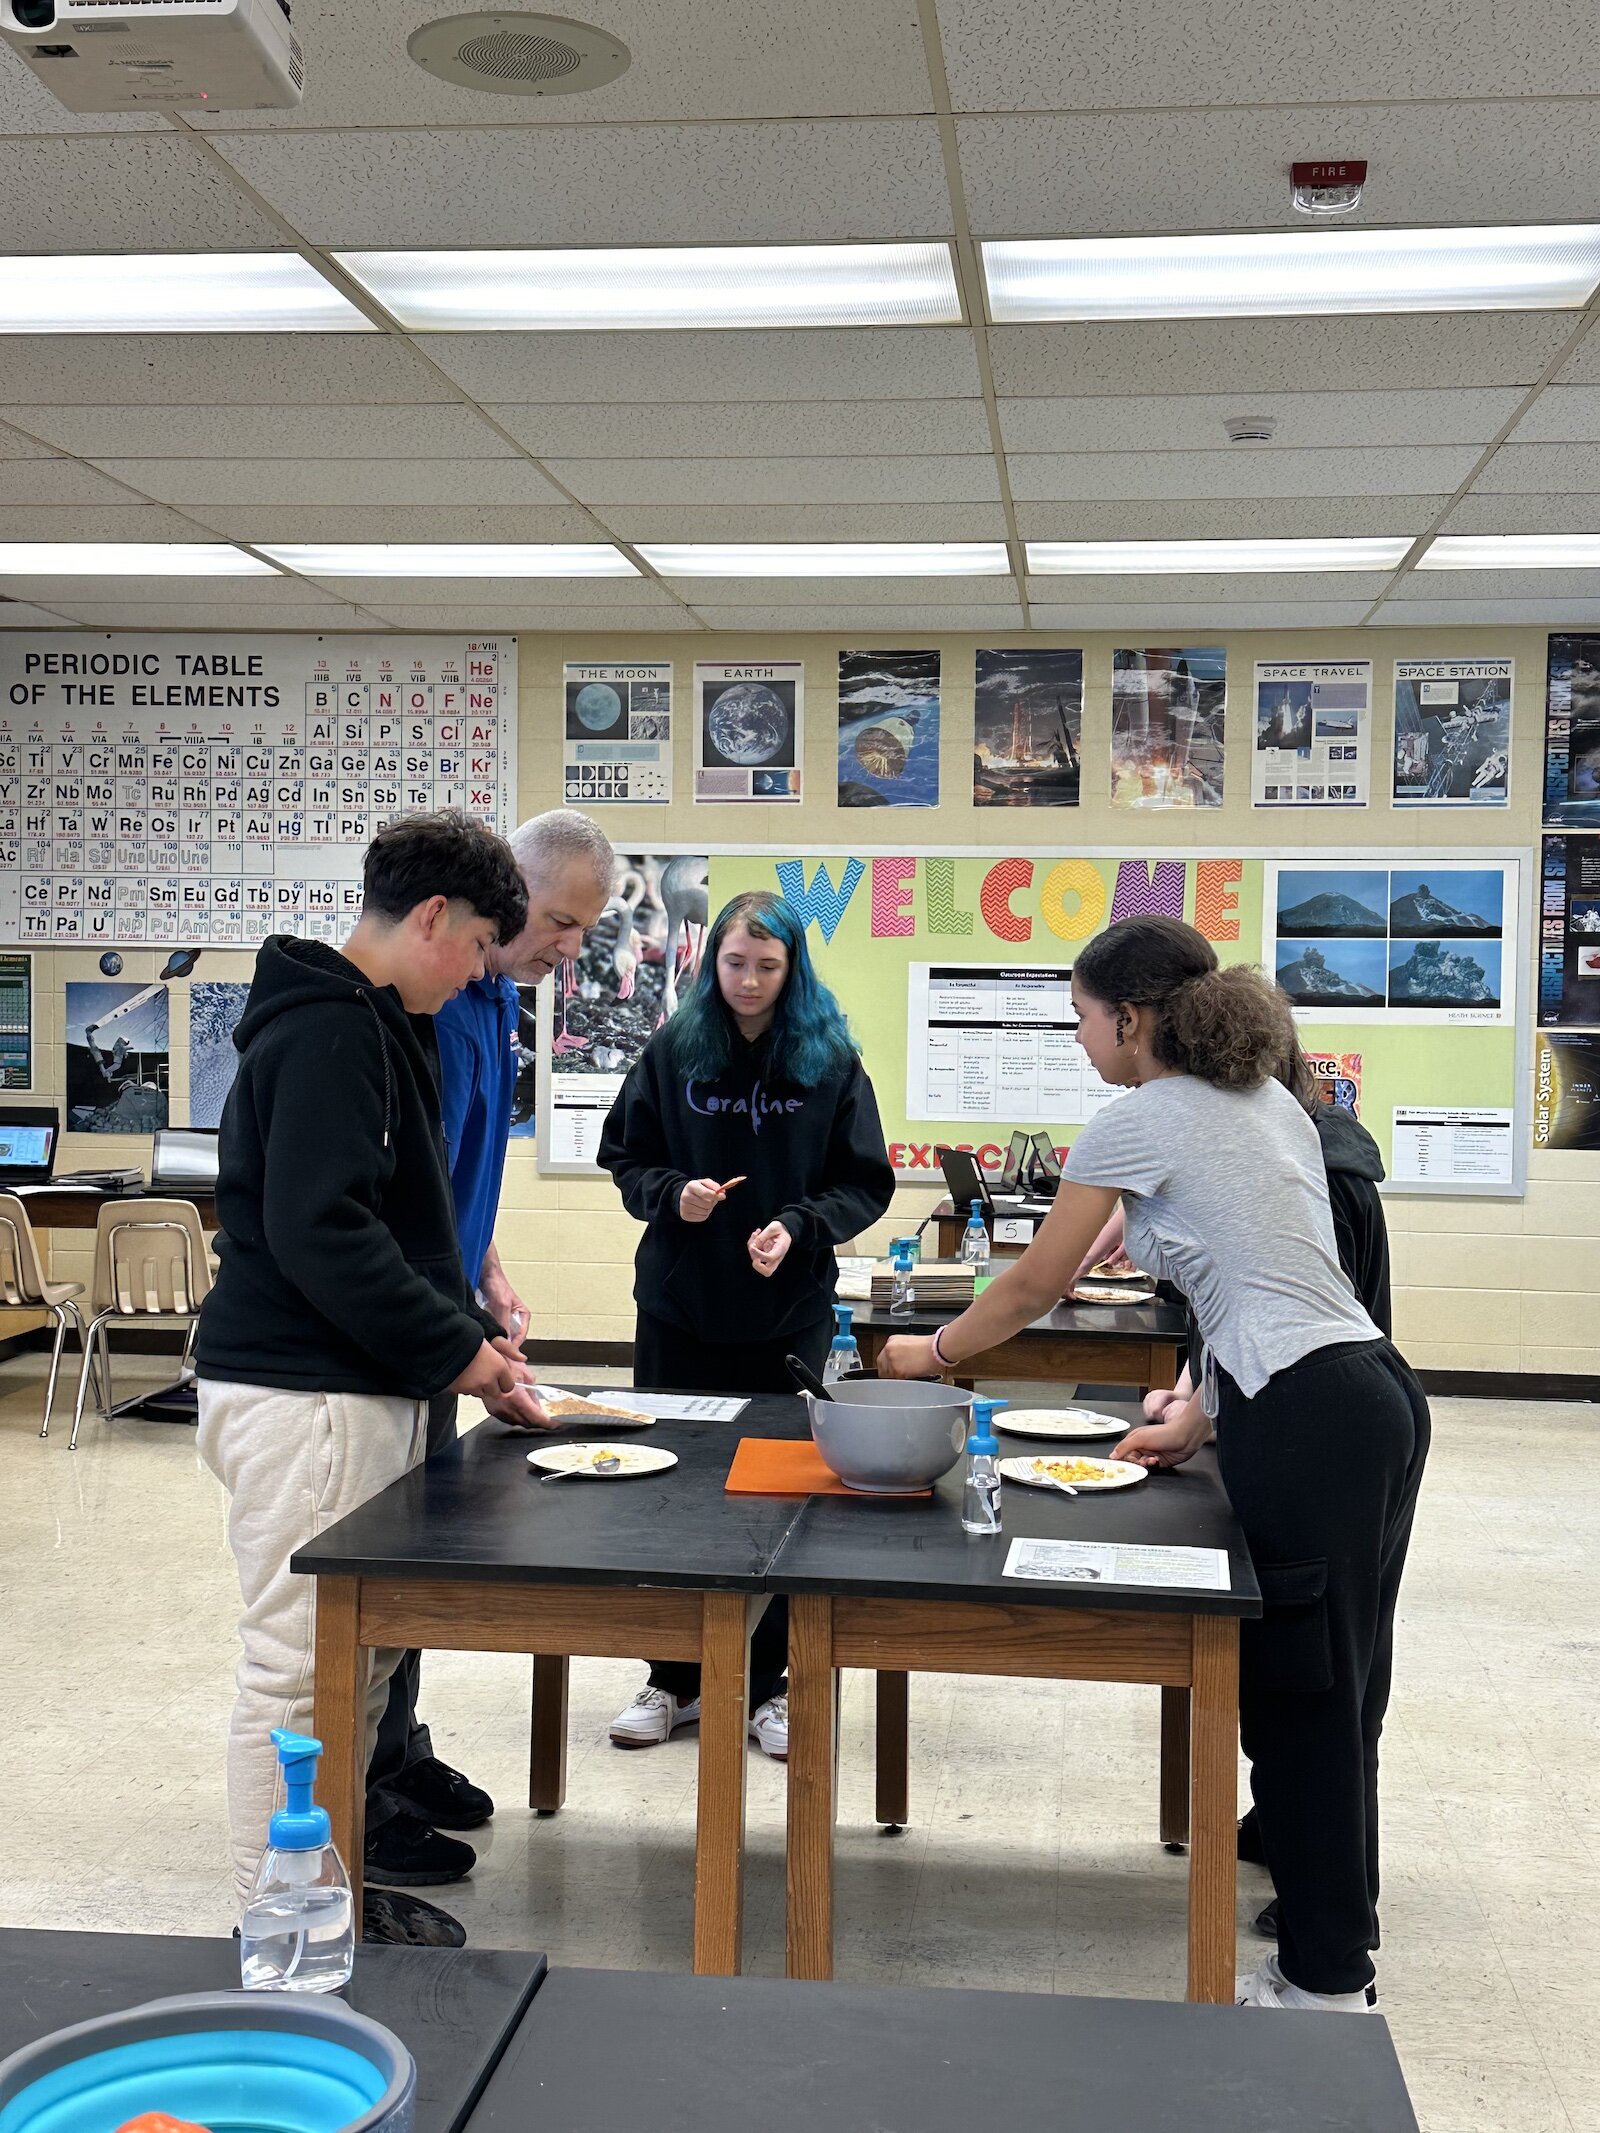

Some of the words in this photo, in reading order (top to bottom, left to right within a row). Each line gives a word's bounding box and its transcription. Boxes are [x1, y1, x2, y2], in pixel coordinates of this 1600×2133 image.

[1312, 166, 1346, 176] FIRE
[25, 653, 160, 676] PERIODIC
[176, 654, 263, 676] TABLE
[471, 662, 492, 675] He
[1399, 667, 1445, 677] SPACE
[1450, 666, 1508, 676] STATION
[380, 674, 392, 682] VB
[579, 669, 608, 678] THE
[615, 669, 657, 678] MOON
[724, 669, 774, 678] EARTH
[1264, 668, 1307, 677] SPACE
[1314, 668, 1363, 676] TRAVEL
[10, 684, 46, 705] OF
[61, 684, 115, 706] THE
[132, 685, 280, 707] ELEMENTS
[316, 693, 327, 706] B
[348, 693, 360, 706] C
[380, 694, 391, 707] N
[412, 694, 424, 707] O
[445, 694, 454, 707] F
[471, 694, 492, 708] Ne
[1549, 680, 1572, 716] FROM
[254, 723, 262, 731] 11
[314, 725, 330, 738] Al
[346, 725, 361, 738] Si
[381, 725, 390, 738] P
[413, 726, 423, 739] S
[442, 726, 458, 740] Cl
[472, 726, 492, 740] Ar
[28, 735, 44, 743] IVA
[62, 735, 74, 743] VA
[92, 735, 107, 743] VIA
[122, 736, 140, 744] VIIA
[29, 753, 43, 767] Ti
[62, 754, 73, 767] V
[90, 754, 109, 767] Cr
[119, 754, 143, 768] Mn
[154, 755, 172, 768] Fe
[183, 755, 206, 769] Co
[218, 756, 234, 769] Ni
[247, 756, 269, 769] Cu
[279, 756, 300, 769] Zn
[310, 757, 333, 770] Ga
[342, 757, 365, 770] Ge
[375, 757, 397, 771] As
[407, 757, 428, 771] Se
[441, 758, 459, 771] Br
[472, 758, 490, 771] Kr
[28, 785, 45, 798] Zr
[57, 785, 79, 799] Nb
[87, 786, 112, 799] Mo
[152, 786, 174, 800] Ru
[184, 787, 205, 800] Rh
[216, 787, 237, 801] Pd
[247, 788, 269, 802] Ag
[278, 788, 301, 802] Cd
[314, 790, 329, 802] In
[343, 789, 364, 802] Sn
[374, 788, 396, 803] Sb
[408, 789, 427, 803] Te
[471, 789, 491, 804] Xe
[28, 817, 45, 830] Hf
[59, 817, 77, 830] Ta
[92, 818, 107, 831] W
[121, 818, 142, 831] Re
[152, 818, 174, 832] Os
[189, 819, 201, 832] Ir
[218, 819, 235, 832] Pt
[247, 820, 269, 833] Au
[279, 820, 300, 835] Hg
[314, 820, 328, 834] Tl
[342, 821, 364, 834] Pb
[26, 885, 47, 899] Ce
[59, 886, 77, 899] Pr
[89, 886, 111, 900] Nd
[150, 887, 176, 901] Sm
[185, 888, 205, 901] Eu
[215, 888, 238, 902] Gd
[248, 889, 268, 902] Tb
[279, 889, 300, 905] Dy
[310, 890, 332, 903] Ho
[344, 890, 362, 903] Er
[775, 857, 1243, 945] WELCOME
[1543, 880, 1566, 916] FROM
[26, 916, 46, 930] Th
[57, 918, 77, 930] Pa
[94, 918, 104, 931] U
[1536, 1049, 1553, 1102] System
[686, 1078, 803, 1136] Coraline
[1535, 1104, 1550, 1142] Solar
[1005, 1223, 1017, 1238] 5
